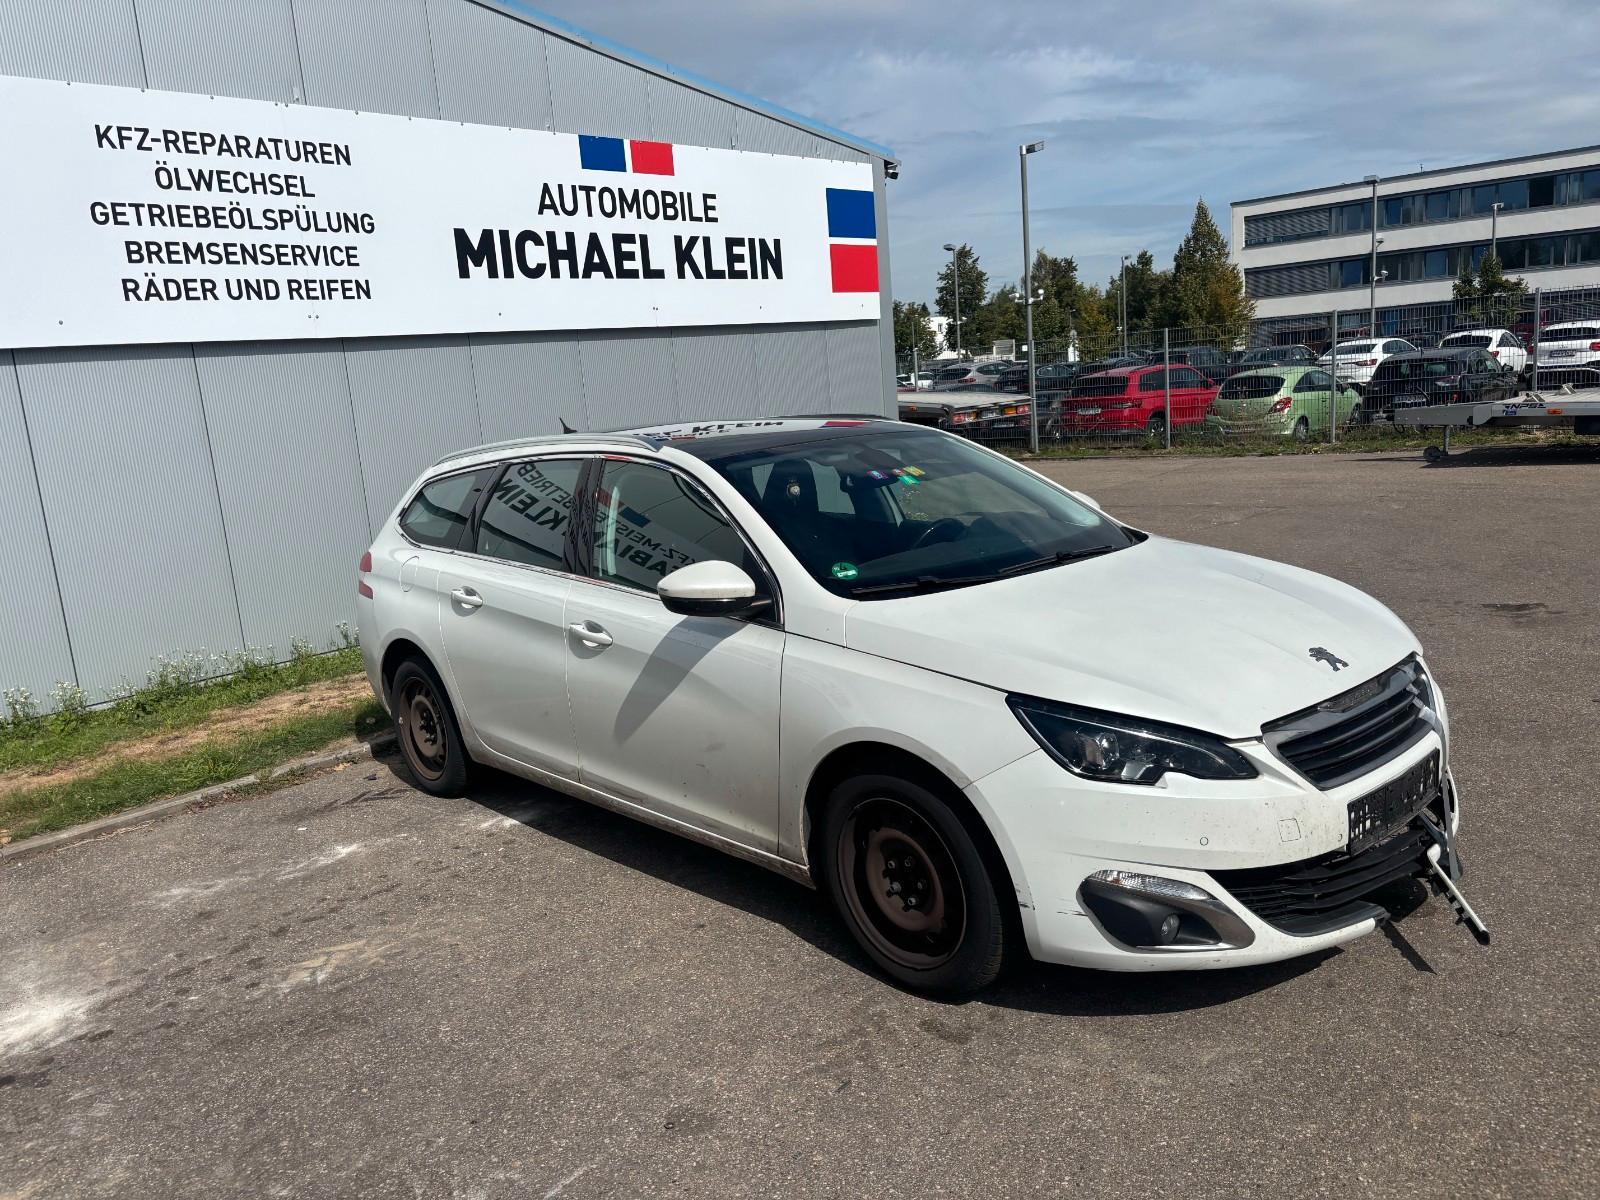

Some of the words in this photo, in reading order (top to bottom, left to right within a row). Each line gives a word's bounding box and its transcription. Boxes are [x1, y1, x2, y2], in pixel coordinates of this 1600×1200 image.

[94, 124, 352, 166] KFZ-REPARATUREN
[154, 160, 316, 198] ÖLWECHSEL
[89, 201, 375, 234] GETRIEBEÖLSPÜLUNG
[537, 182, 719, 223] AUTOMOBILE
[124, 240, 360, 267] BREMSENSERVICE
[453, 227, 666, 280] MICHAEL
[673, 234, 784, 280] KLEIN
[121, 272, 220, 302] RÄDER
[224, 278, 281, 301] UND
[286, 278, 372, 301] REIFEN
